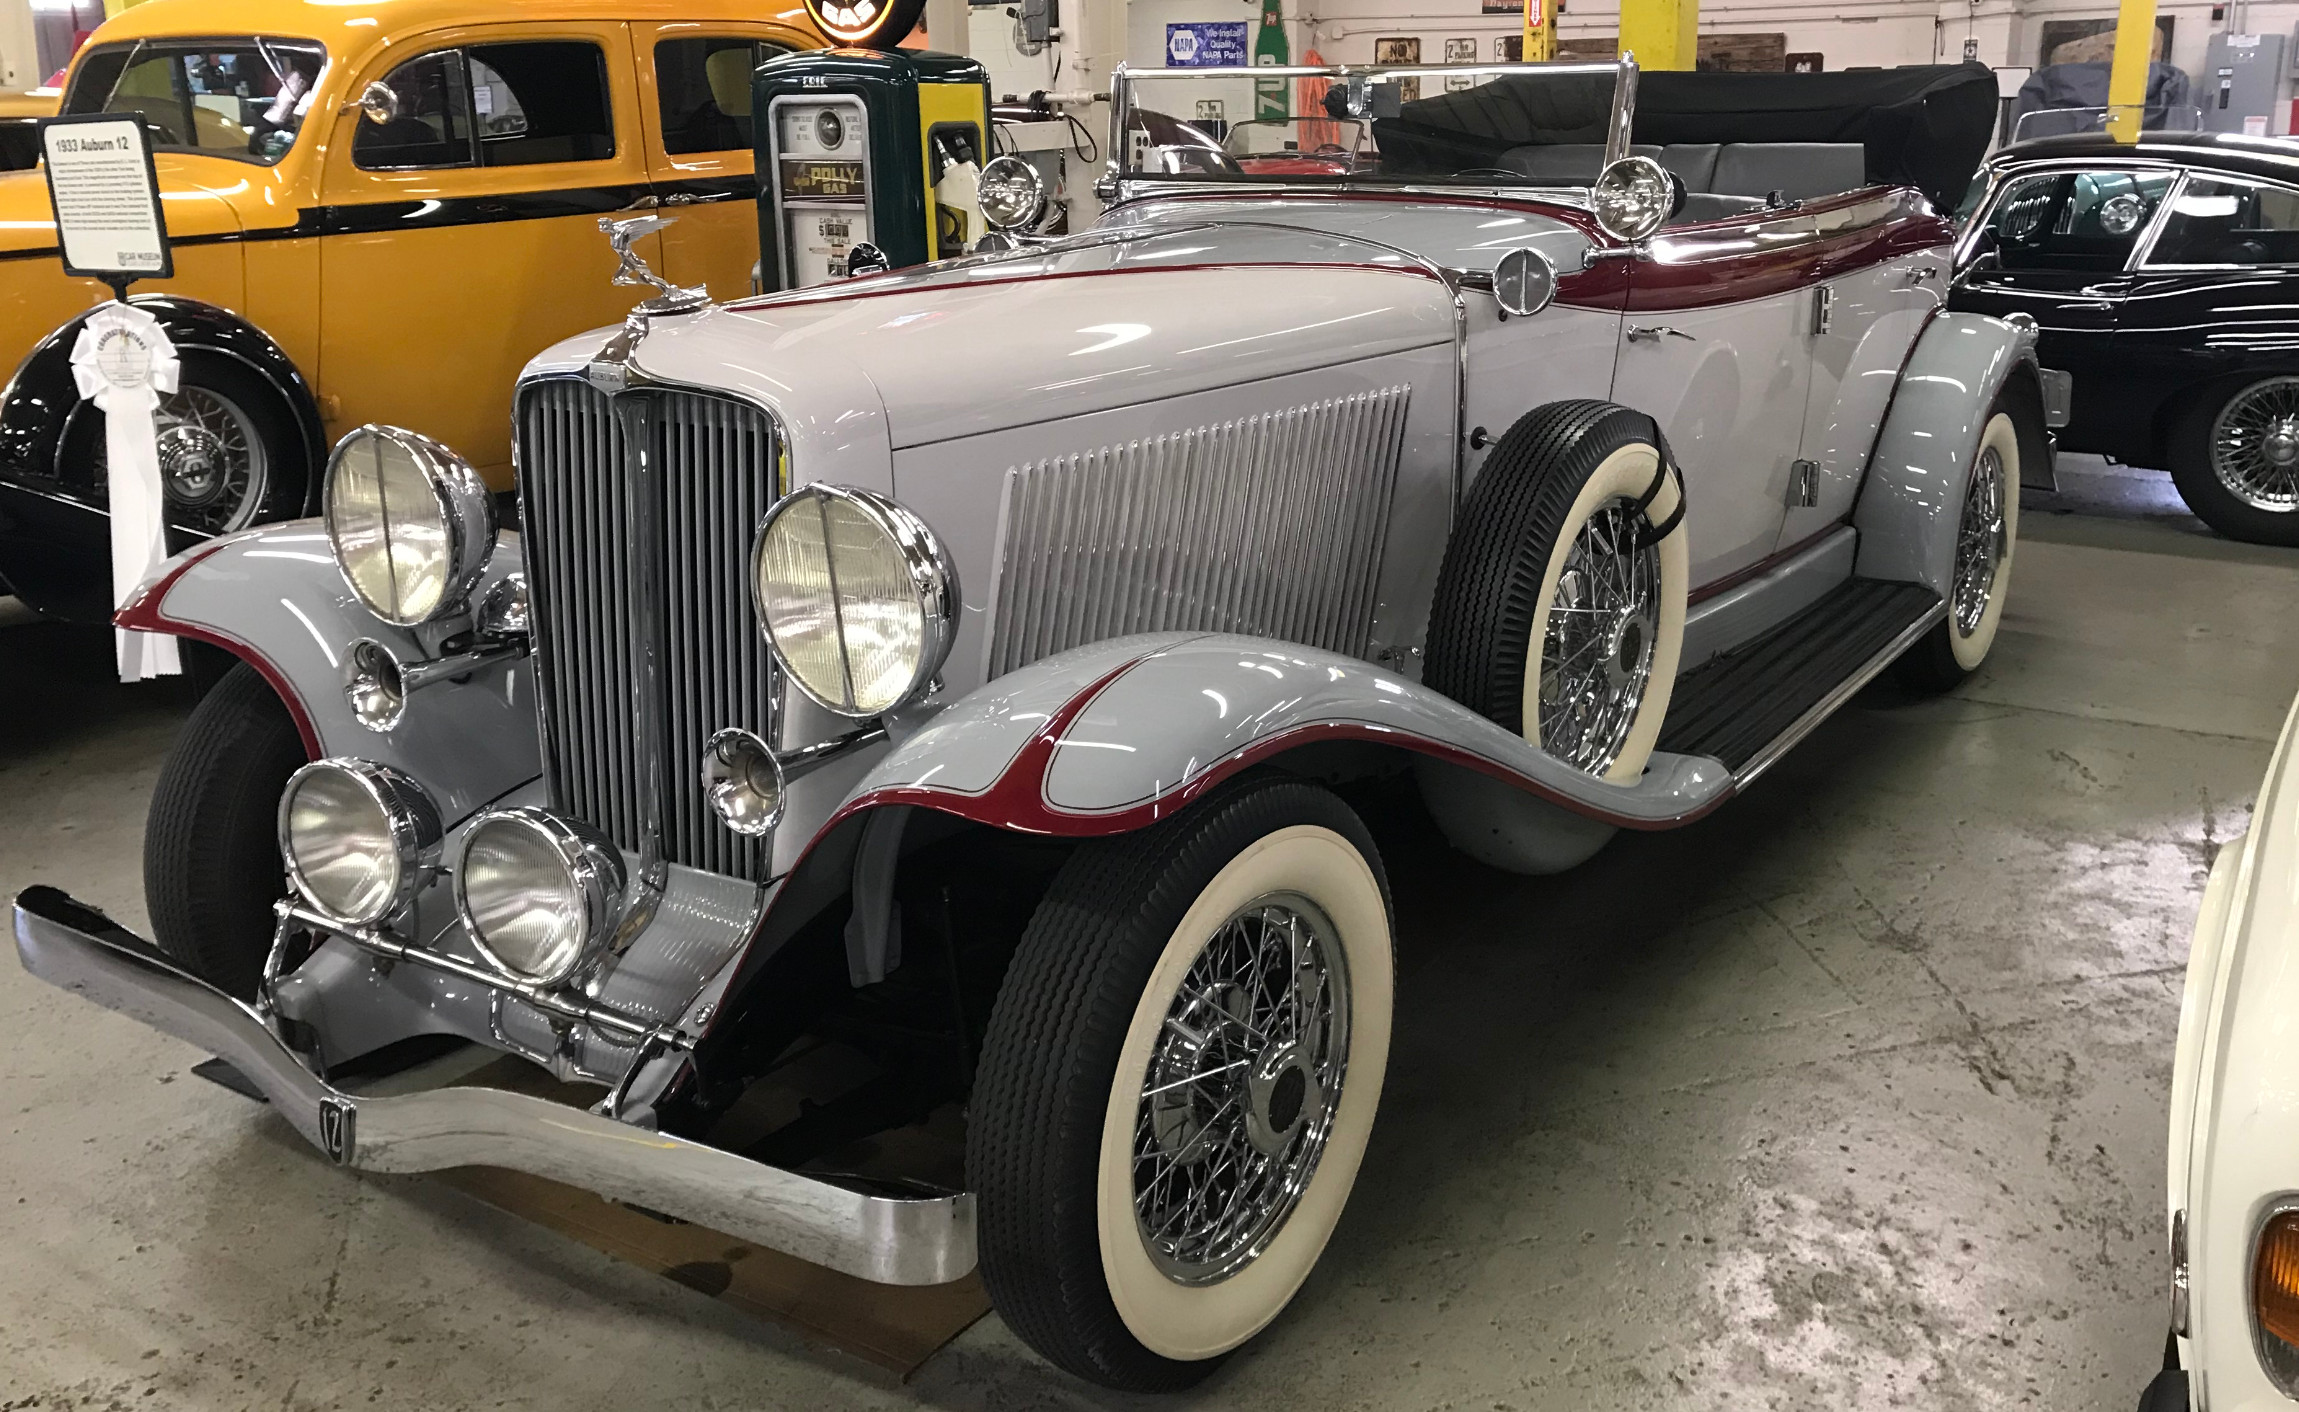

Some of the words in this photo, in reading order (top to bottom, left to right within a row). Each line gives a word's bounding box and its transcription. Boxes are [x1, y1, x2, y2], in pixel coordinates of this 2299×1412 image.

[822, 0, 876, 27] GAS
[1205, 28, 1218, 37] We
[1220, 28, 1241, 37] Install
[1174, 38, 1193, 51] NAPA
[1210, 40, 1236, 49] Quality
[1390, 44, 1407, 57] NO
[1497, 43, 1502, 56] 2
[1448, 45, 1454, 58] 2
[56, 139, 78, 152] 1933
[81, 138, 114, 151] Auburn
[116, 136, 129, 149] 12
[811, 167, 857, 185] POLLY
[823, 183, 847, 194] GAS
